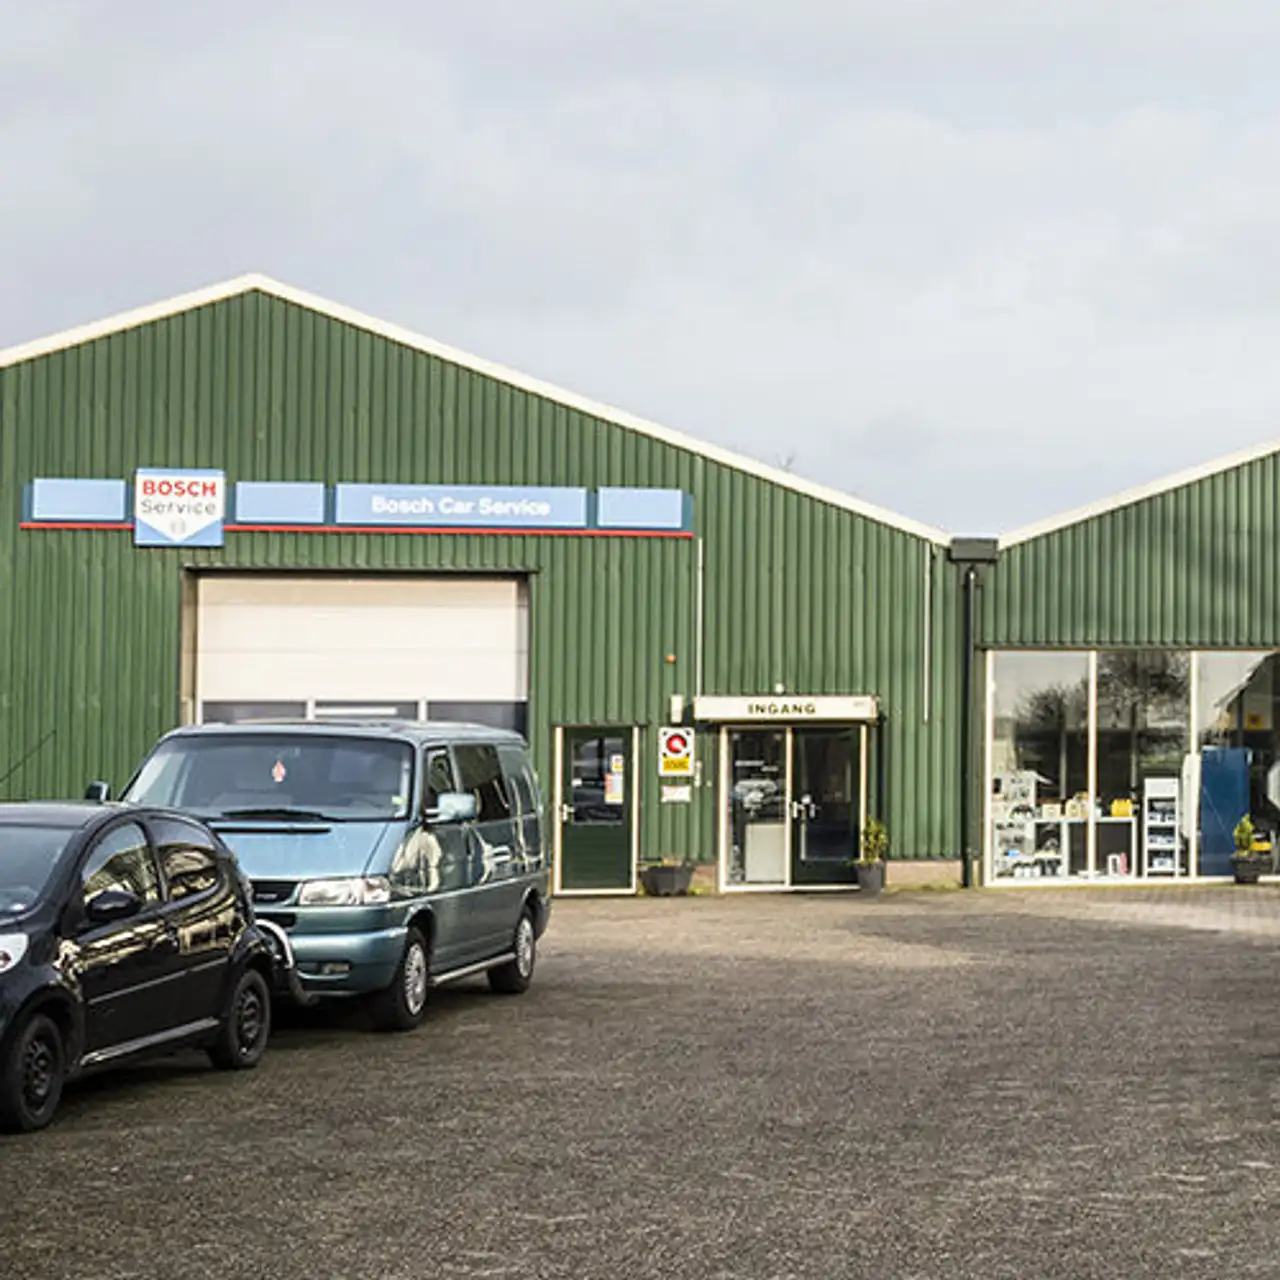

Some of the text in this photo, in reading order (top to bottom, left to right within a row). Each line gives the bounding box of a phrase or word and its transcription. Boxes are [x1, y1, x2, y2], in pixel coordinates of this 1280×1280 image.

[142, 480, 216, 496] BOSCH
[141, 500, 216, 515] Service
[372, 496, 551, 516] Bosch Car Service
[747, 703, 806, 715] INGANG
